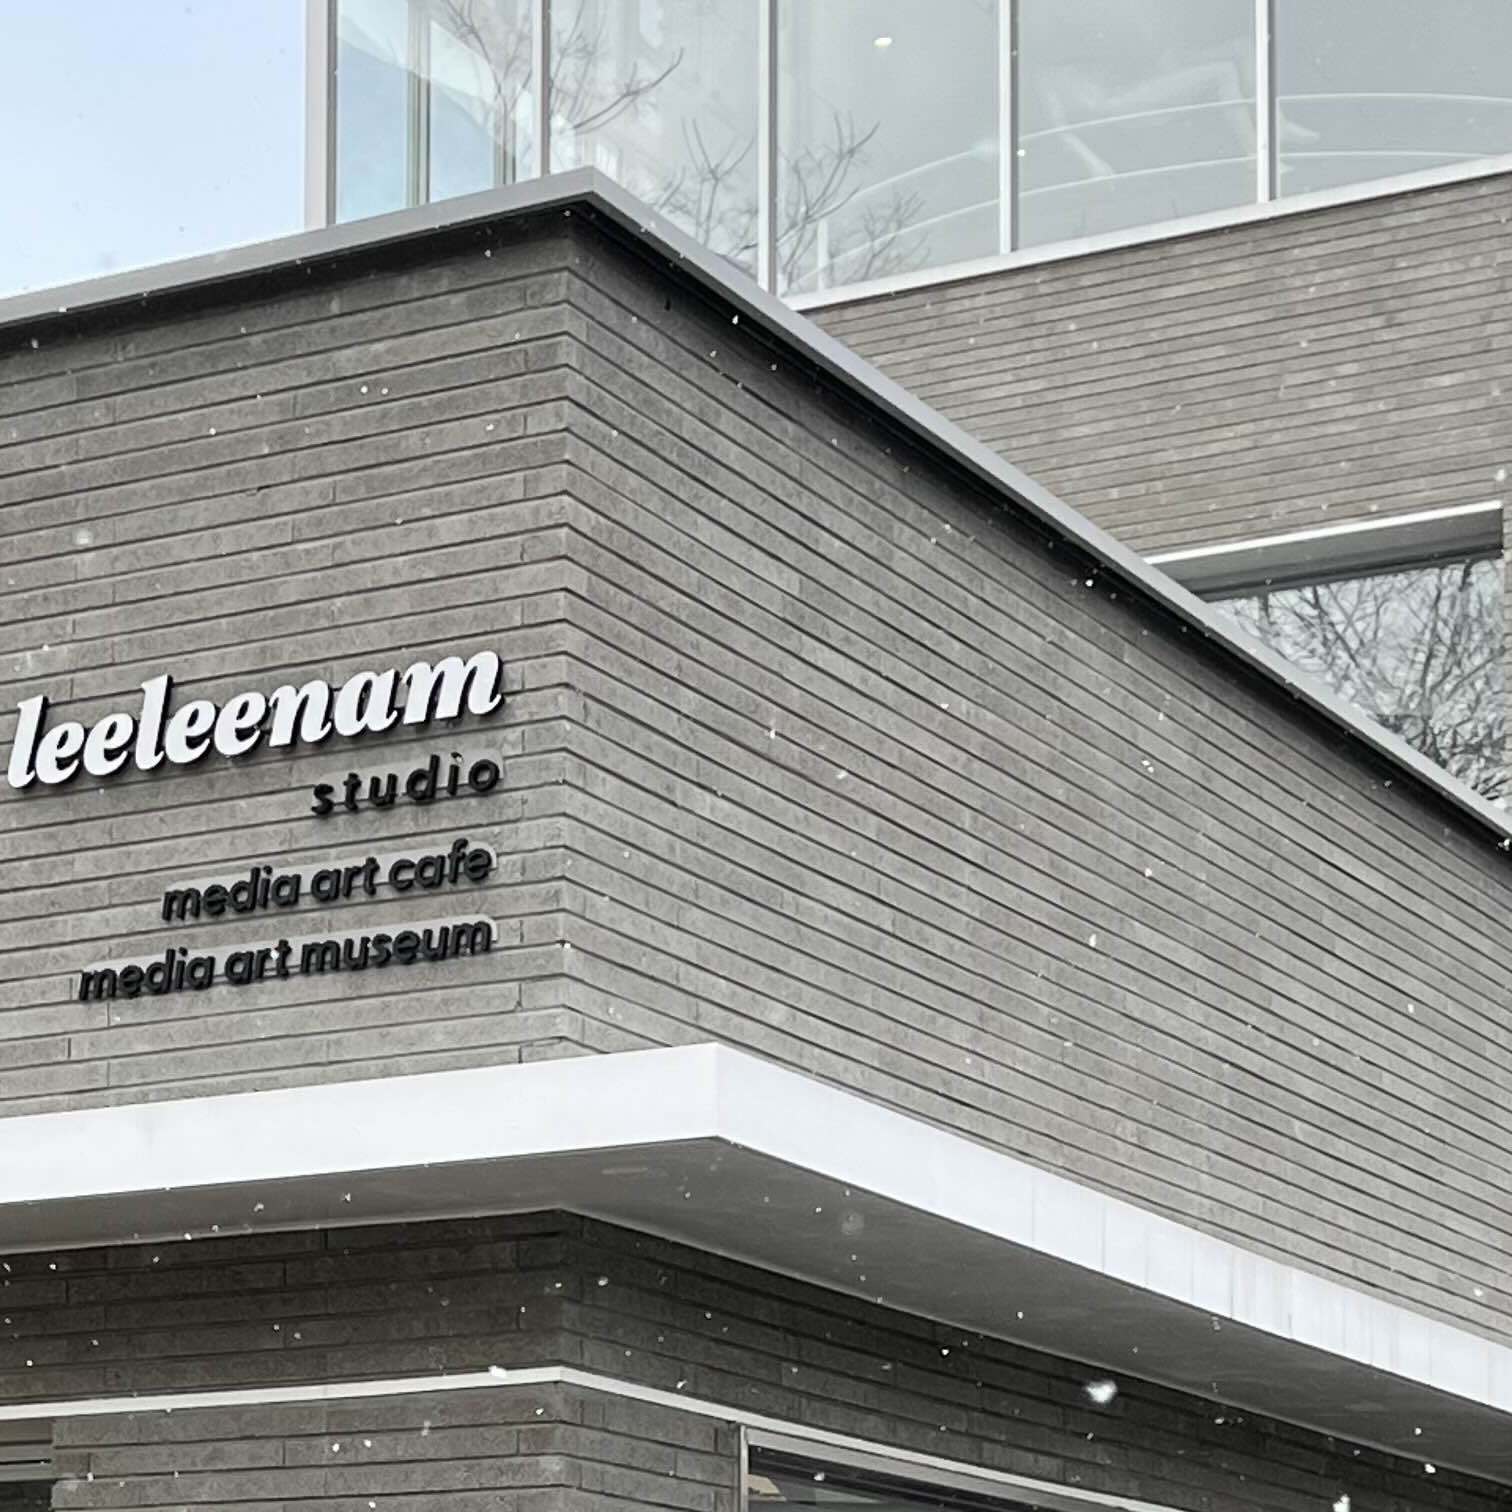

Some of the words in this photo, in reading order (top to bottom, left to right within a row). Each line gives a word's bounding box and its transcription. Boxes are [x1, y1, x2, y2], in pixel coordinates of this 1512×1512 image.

[7, 651, 503, 789] leeleenam
[311, 752, 501, 816] studio
[161, 865, 301, 922] media
[311, 857, 380, 901] art
[389, 838, 492, 893] cafe
[79, 947, 215, 1001] media
[224, 939, 292, 985] art
[300, 919, 492, 975] museum
